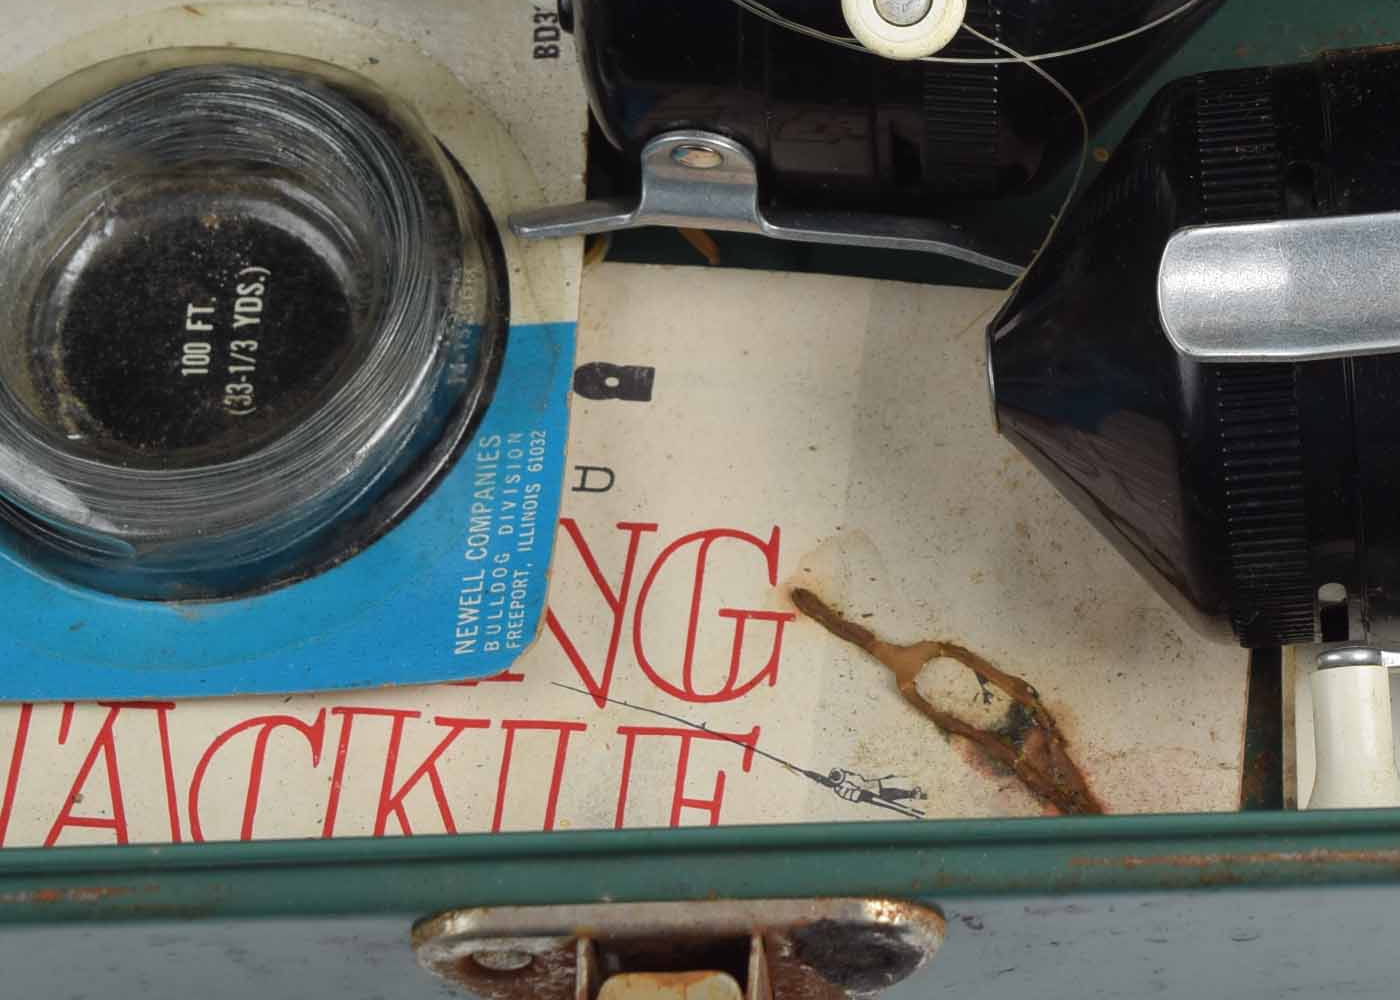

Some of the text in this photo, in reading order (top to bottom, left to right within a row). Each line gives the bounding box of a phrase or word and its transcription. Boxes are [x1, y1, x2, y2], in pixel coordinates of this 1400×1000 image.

[532, 6, 561, 60] BD3
[181, 296, 216, 377] 100 FT.
[224, 265, 271, 416] (33-1/3 YDS.)
[453, 434, 502, 655] NEWELL COMPANIES
[484, 431, 523, 652] BULLDOG DIVISION
[505, 429, 547, 649] FREEPORT, ILLINOIS 61032
